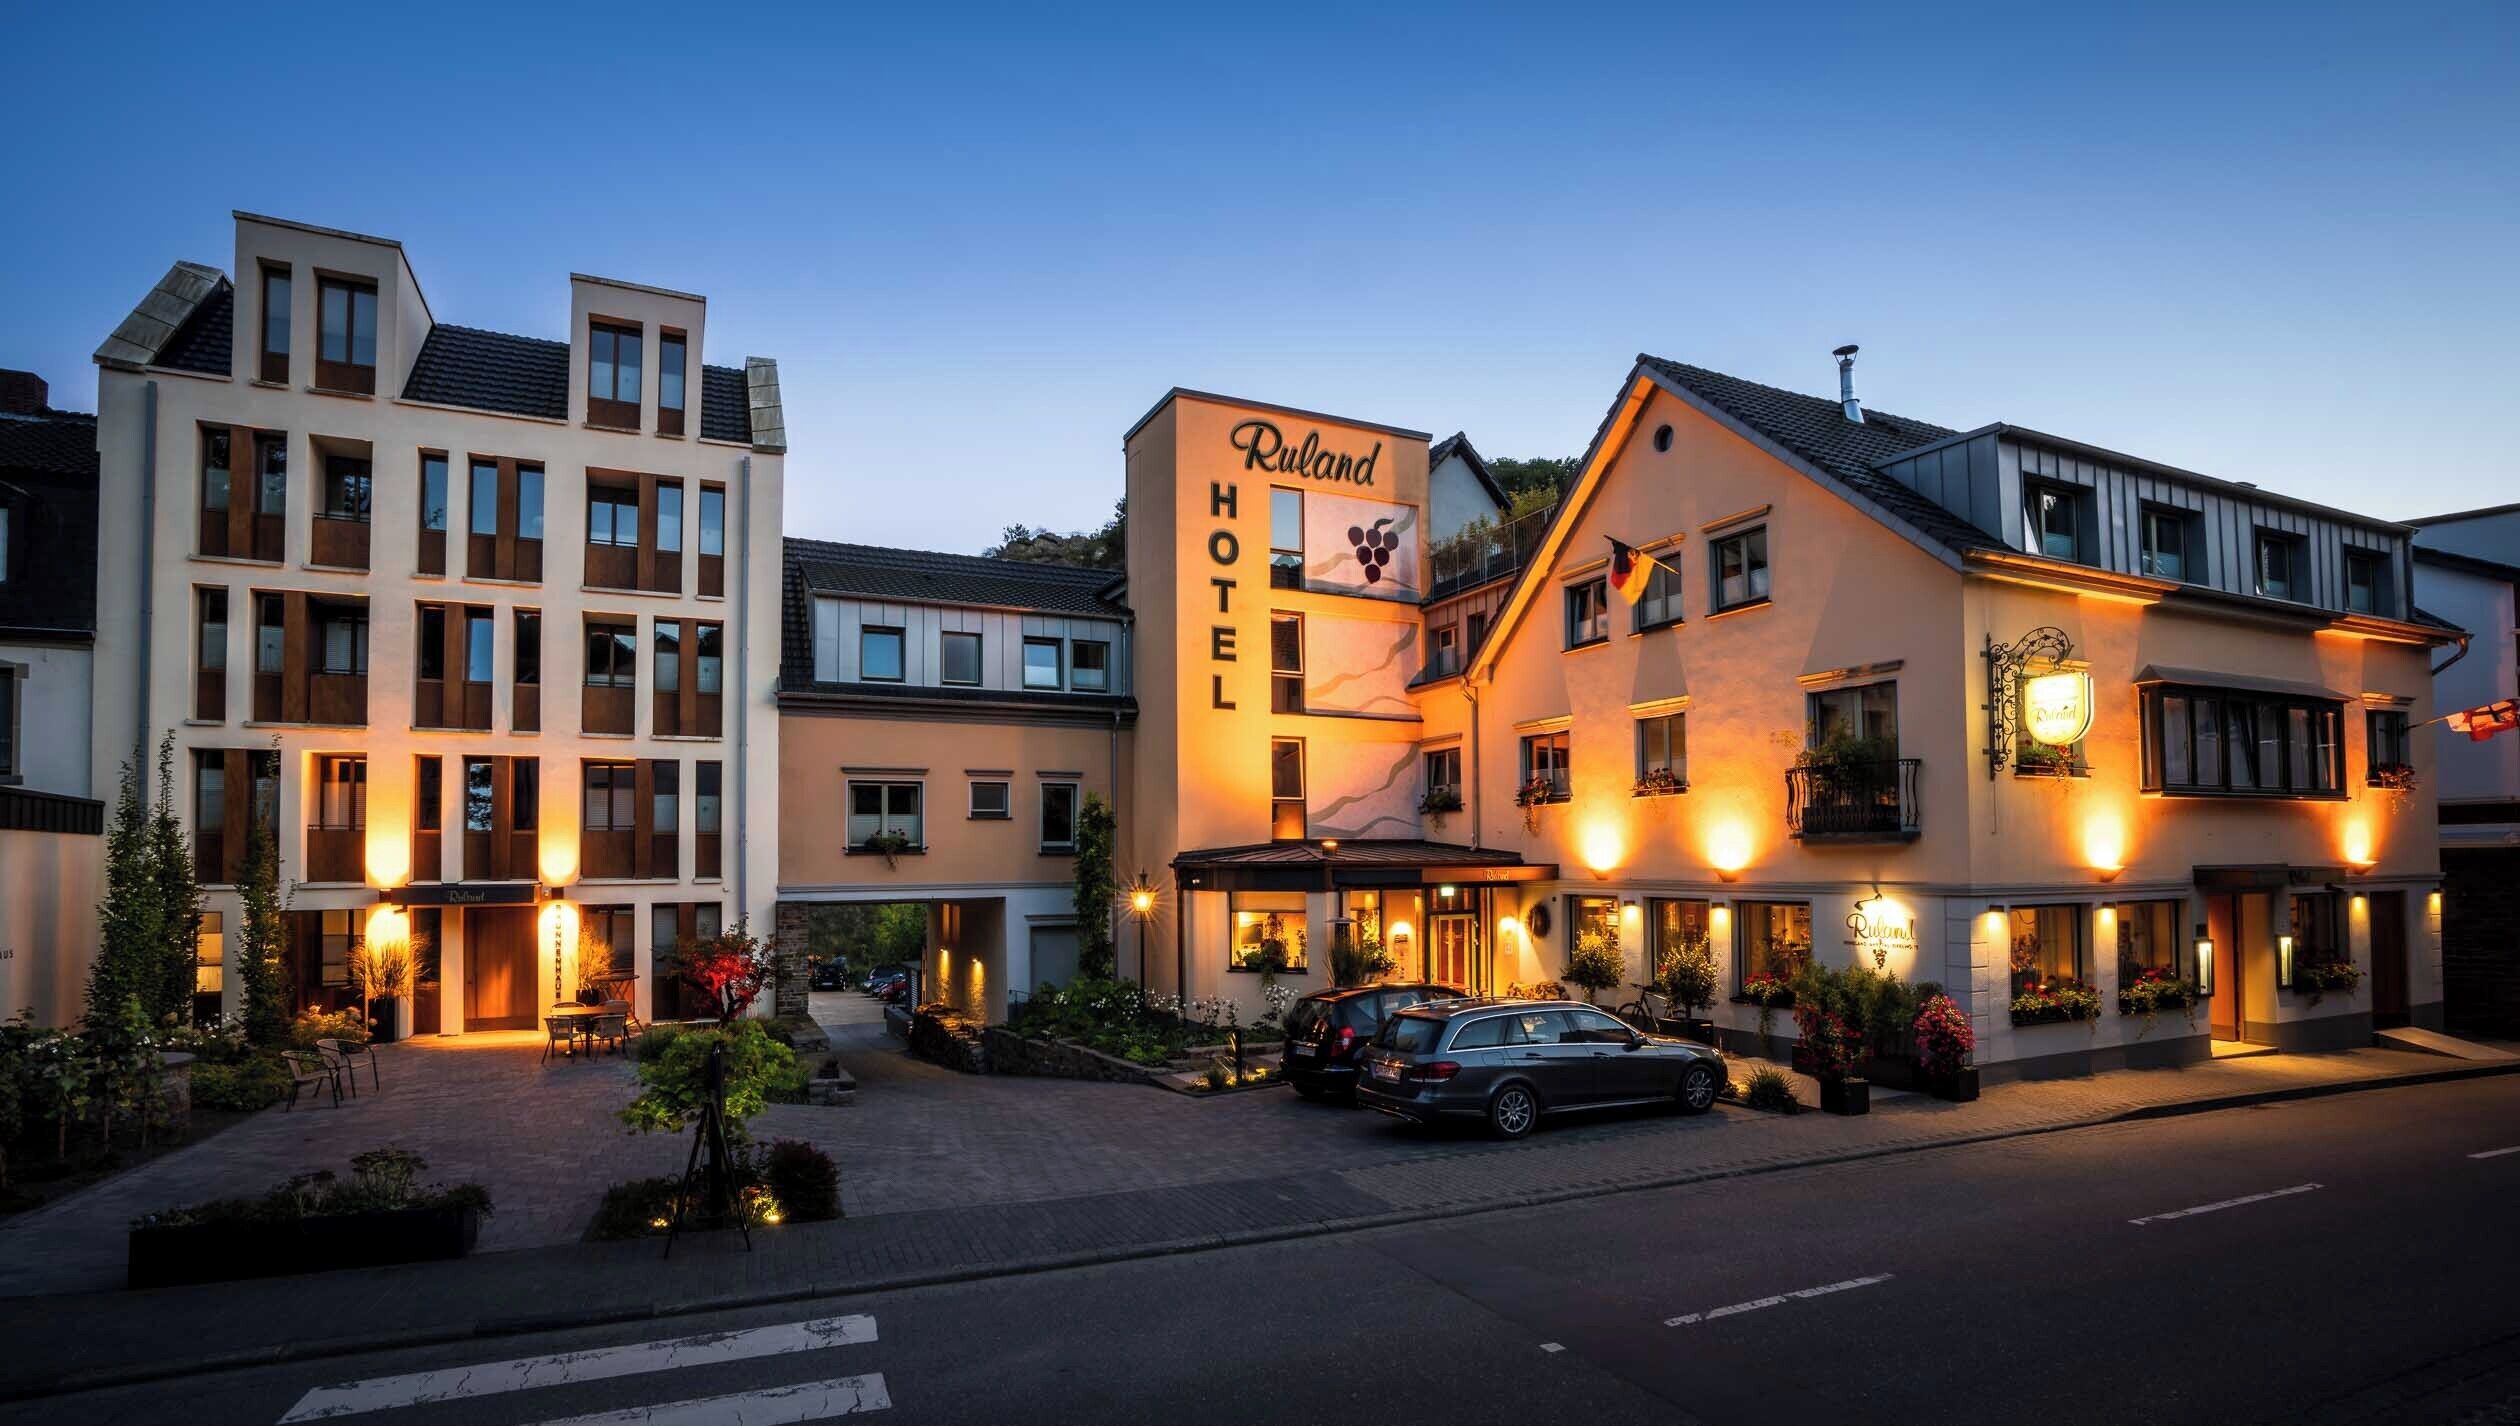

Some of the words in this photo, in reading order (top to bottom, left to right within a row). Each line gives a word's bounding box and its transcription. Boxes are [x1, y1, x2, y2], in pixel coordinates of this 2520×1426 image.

[1231, 420, 1381, 486] Ruland
[1208, 481, 1239, 711] HOTEL
[1847, 913, 1917, 940] Ruland
